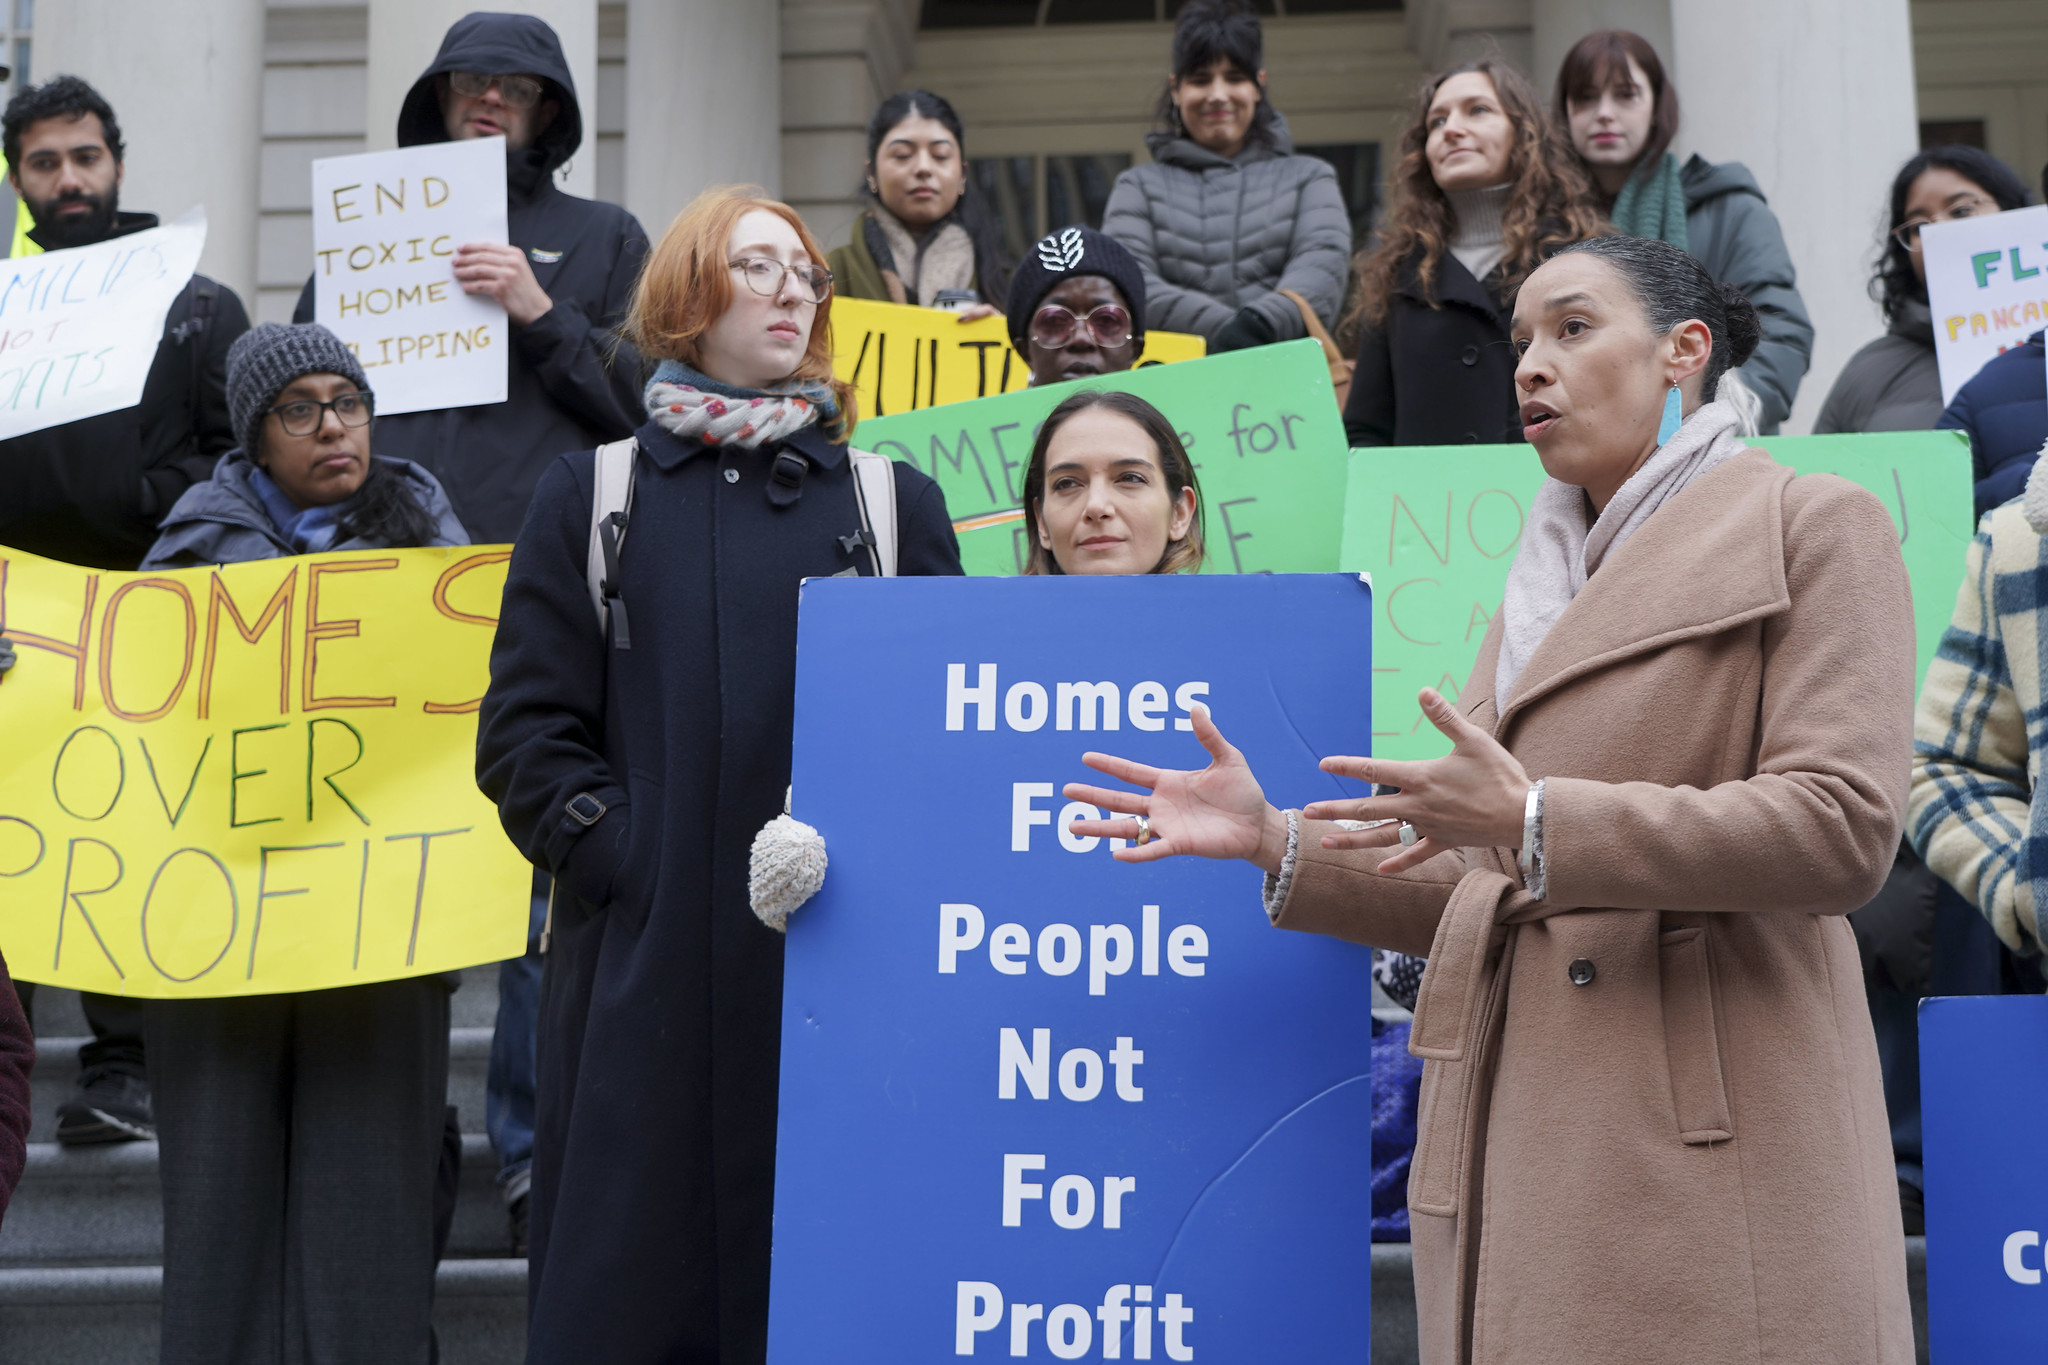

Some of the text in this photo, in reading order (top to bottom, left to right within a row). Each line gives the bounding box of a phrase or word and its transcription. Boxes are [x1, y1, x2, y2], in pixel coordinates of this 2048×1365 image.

[332, 177, 451, 223] END
[317, 235, 454, 275] TOXIC
[1971, 242, 2048, 289] FL
[339, 281, 450, 319] HOME
[343, 325, 492, 369] LIPPING
[1227, 403, 1305, 458] for
[945, 663, 1212, 732] Homes
[53, 718, 370, 829] OVER
[938, 903, 1209, 996] People
[999, 1027, 1144, 1102] Not
[1002, 1153, 1136, 1230] For
[955, 1280, 1194, 1362] Profit
